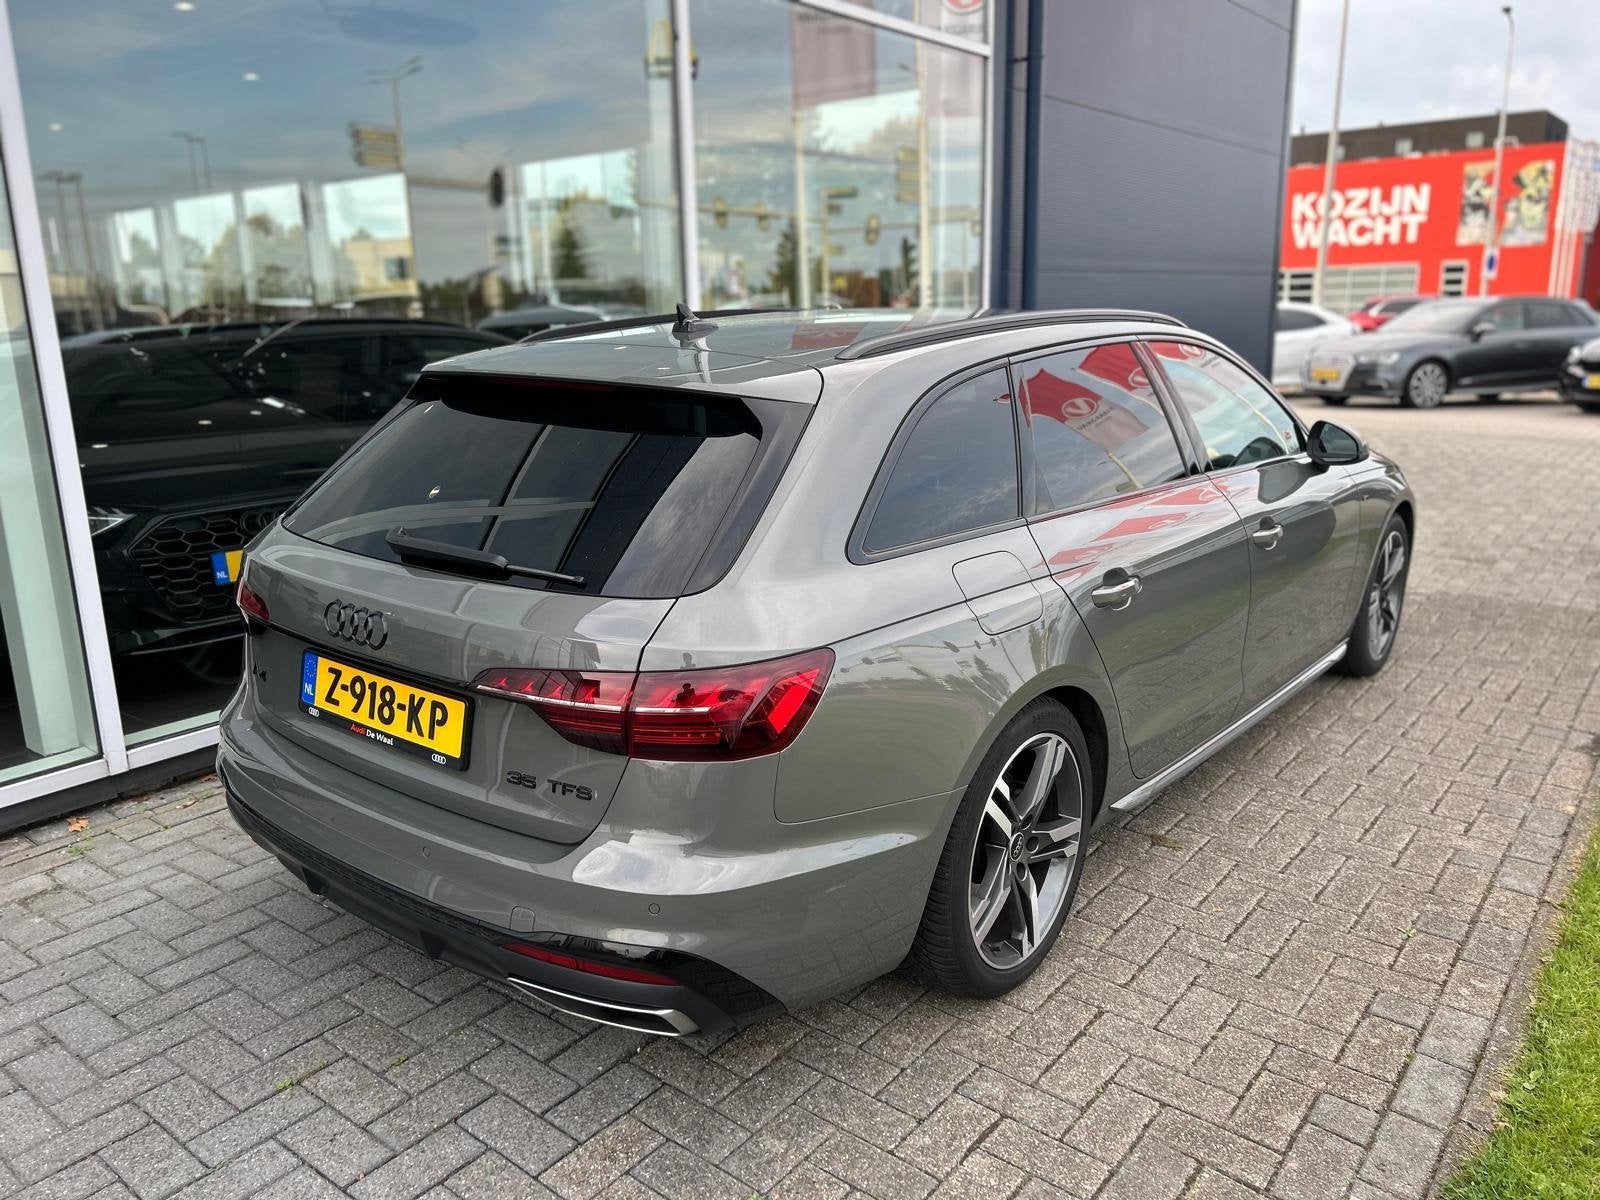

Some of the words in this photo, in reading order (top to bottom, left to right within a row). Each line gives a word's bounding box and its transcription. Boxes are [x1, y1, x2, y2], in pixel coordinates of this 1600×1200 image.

[1291, 182, 1431, 220] KOZIJN
[1291, 213, 1429, 250] WACHT
[216, 570, 228, 580] NL
[303, 682, 315, 696] NL
[324, 666, 450, 741] Z-918-KP
[350, 723, 366, 736] Audi
[366, 728, 376, 739] De
[375, 732, 394, 746] Waal
[506, 770, 537, 790] 35
